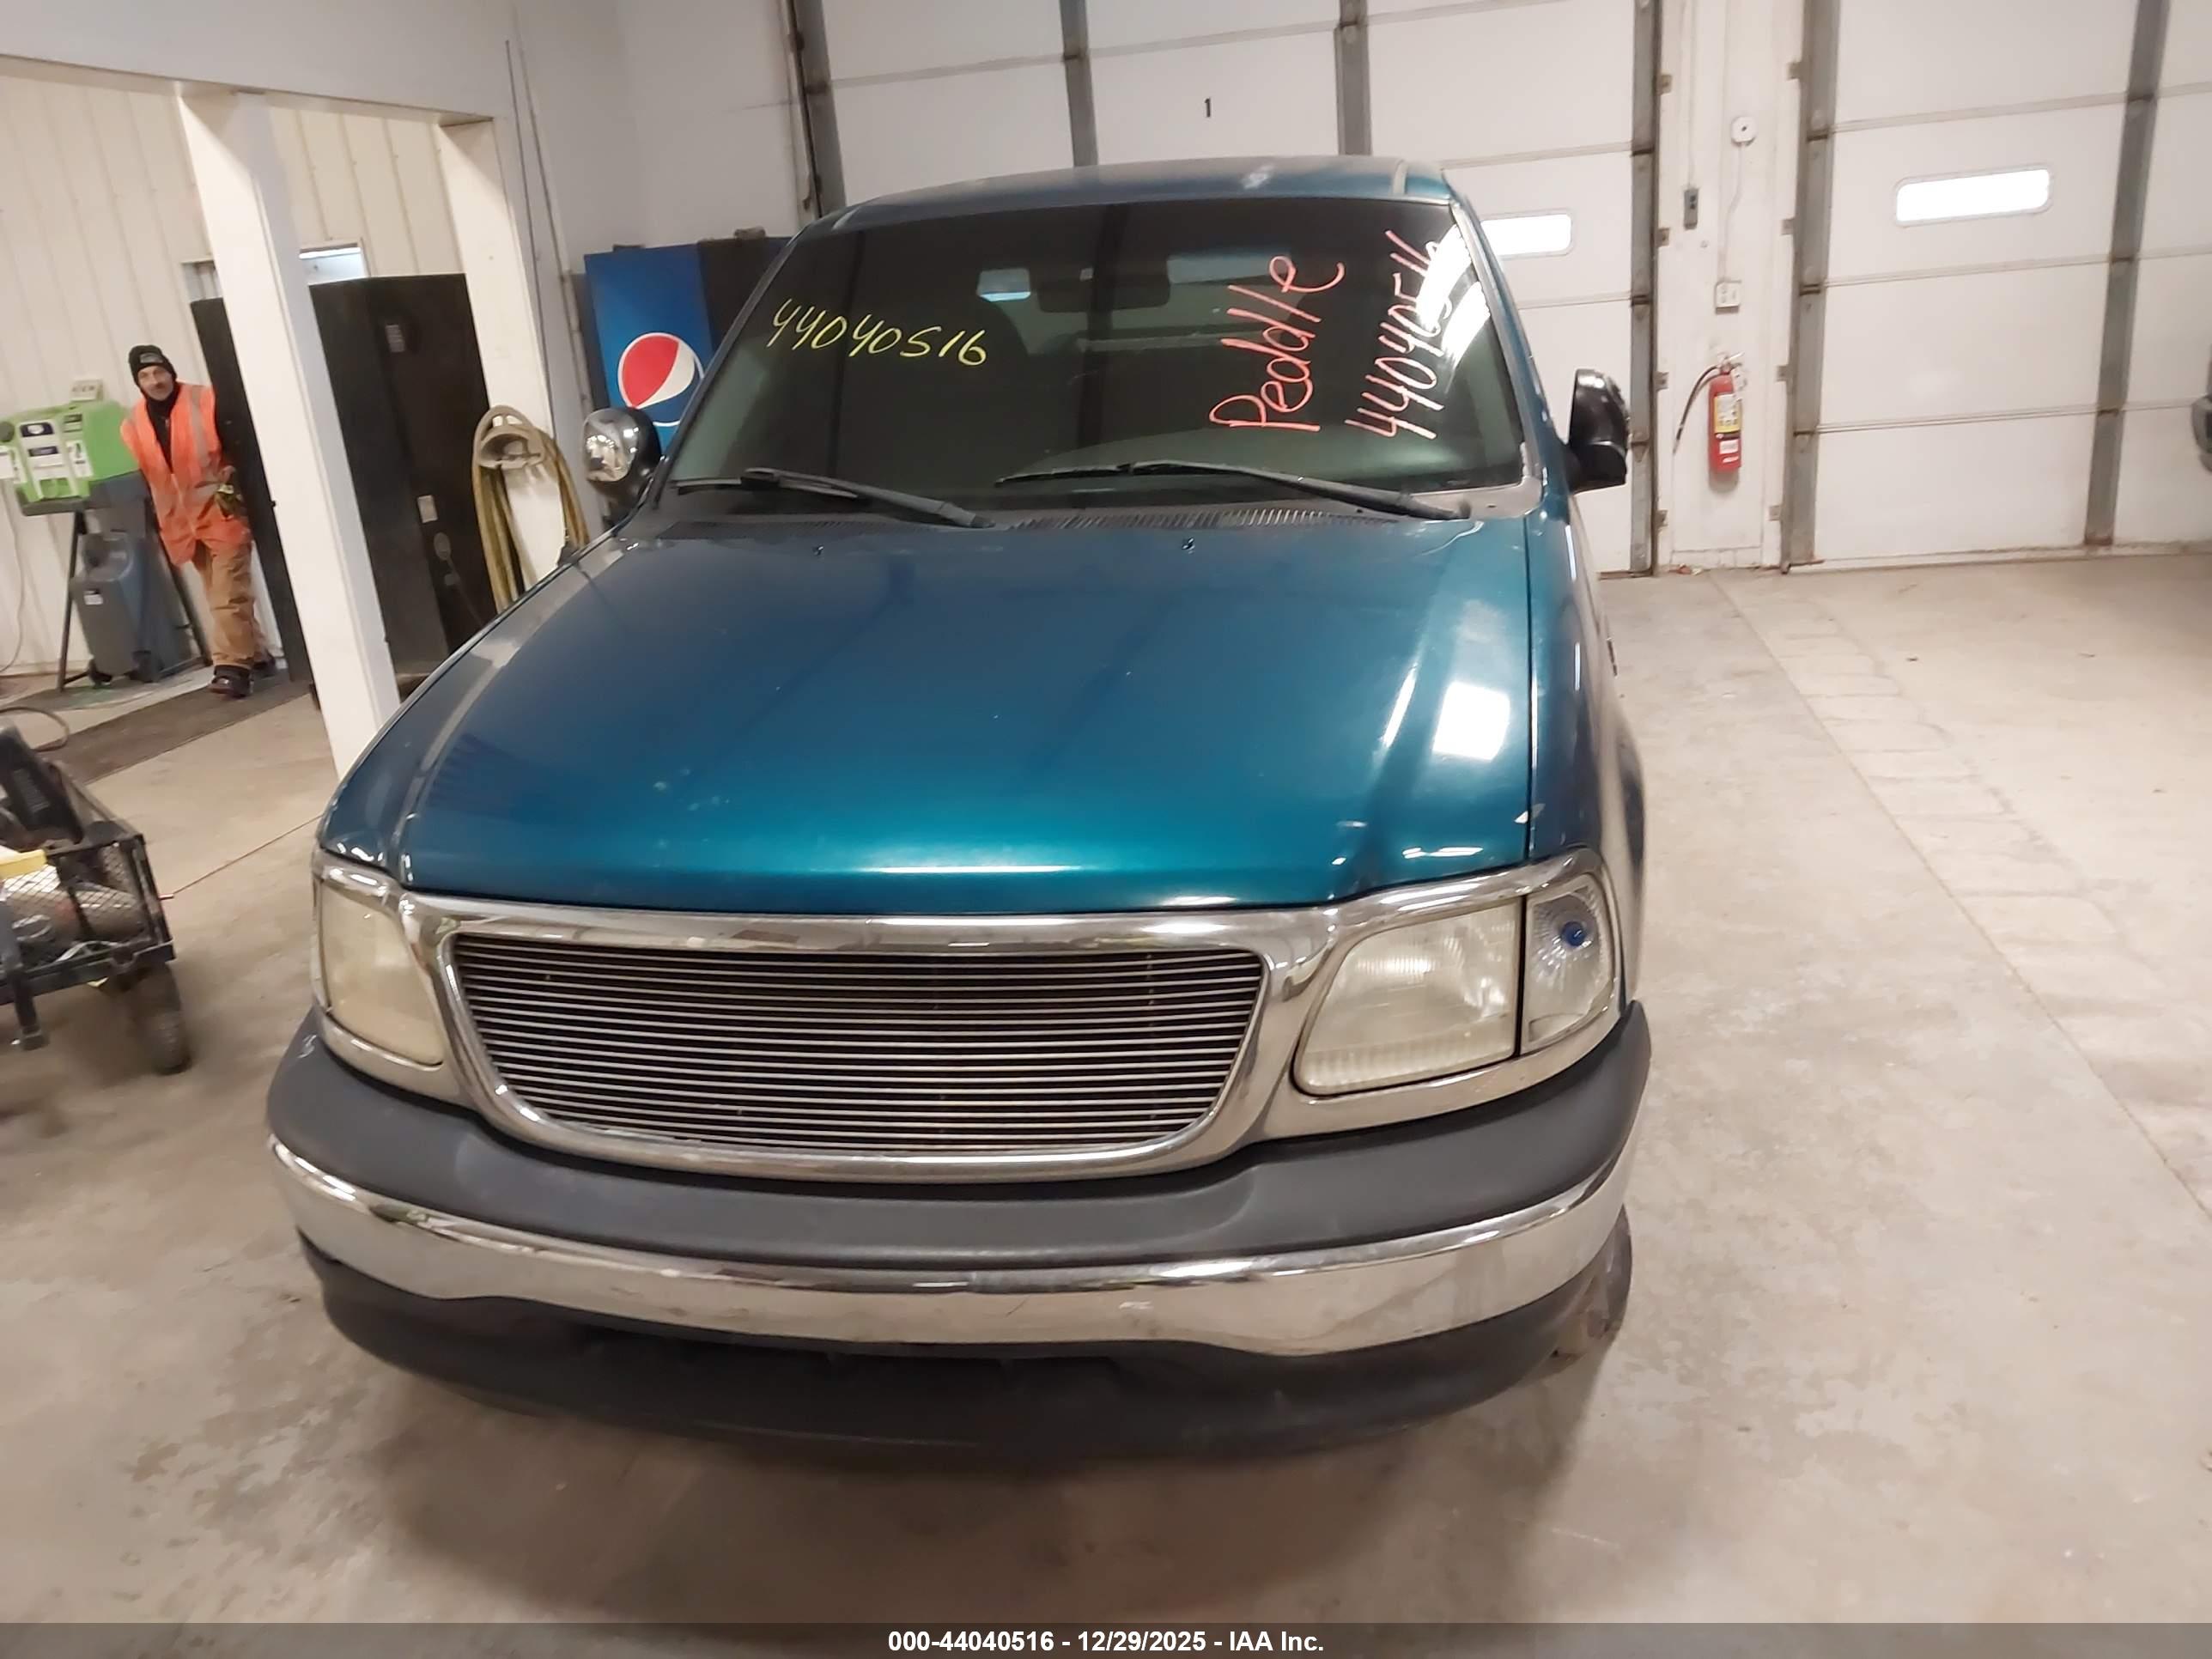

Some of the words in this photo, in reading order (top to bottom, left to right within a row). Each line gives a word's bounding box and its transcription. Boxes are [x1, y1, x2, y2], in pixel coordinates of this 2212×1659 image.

[1204, 97, 1212, 118] 1
[766, 298, 988, 366] 44040516
[1209, 255, 1346, 432] Peddle
